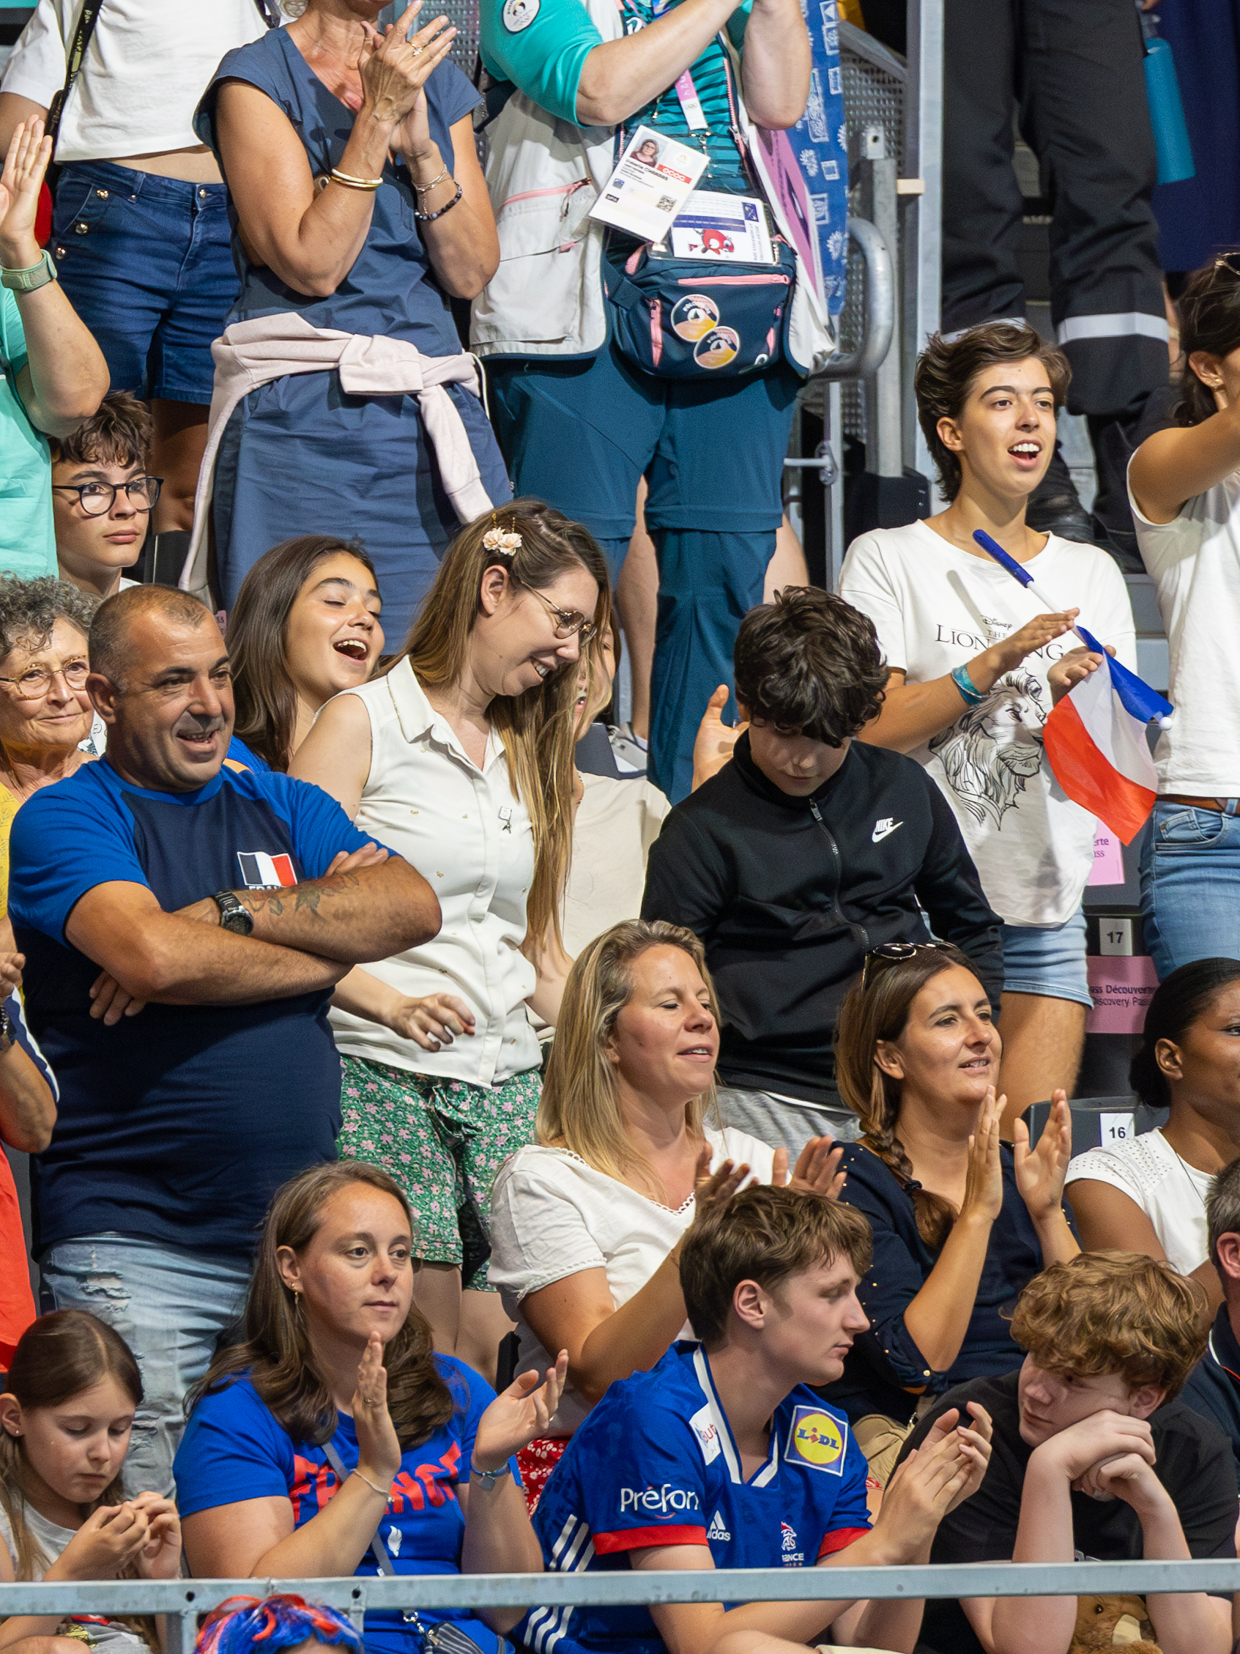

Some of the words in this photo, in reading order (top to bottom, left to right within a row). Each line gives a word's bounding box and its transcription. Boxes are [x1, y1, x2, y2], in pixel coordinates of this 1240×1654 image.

[980, 614, 1013, 630] Disney
[874, 817, 894, 832] NIKE
[1106, 931, 1124, 944] 17
[1109, 1126, 1126, 1139] 16
[620, 1483, 700, 1513] Préfon
